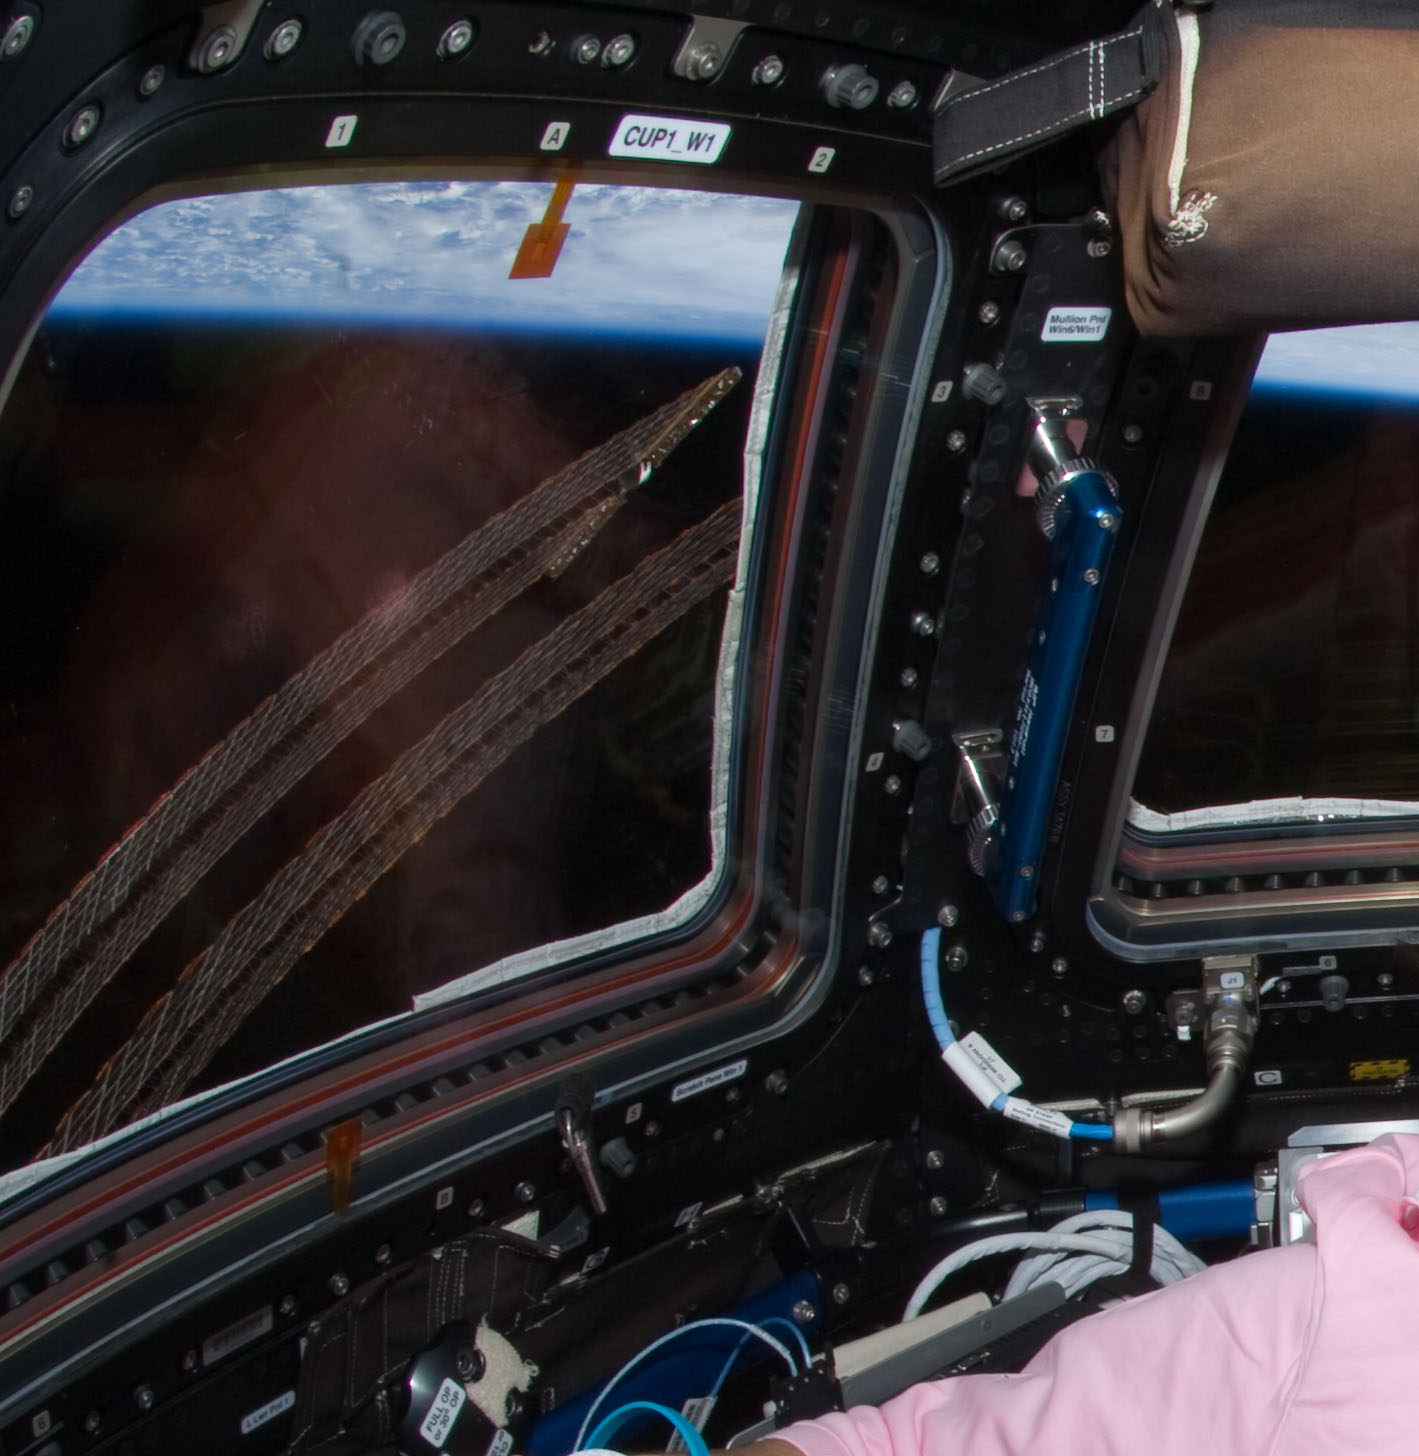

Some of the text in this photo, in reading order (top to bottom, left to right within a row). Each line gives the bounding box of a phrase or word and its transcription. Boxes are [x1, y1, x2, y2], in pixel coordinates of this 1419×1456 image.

[336, 121, 349, 141] 1
[548, 126, 561, 146] A
[624, 124, 719, 155] CUP1_W1
[815, 151, 829, 170] 2
[1049, 313, 1107, 325] Mullion Pnl
[1048, 324, 1102, 336] Win6/Win1
[1101, 728, 1109, 740] 7
[1325, 958, 1332, 967] 6
[1259, 1073, 1278, 1084] C
[427, 1387, 452, 1433] FULL OP
[435, 1427, 444, 1440] or
[449, 1391, 460, 1410] OP
